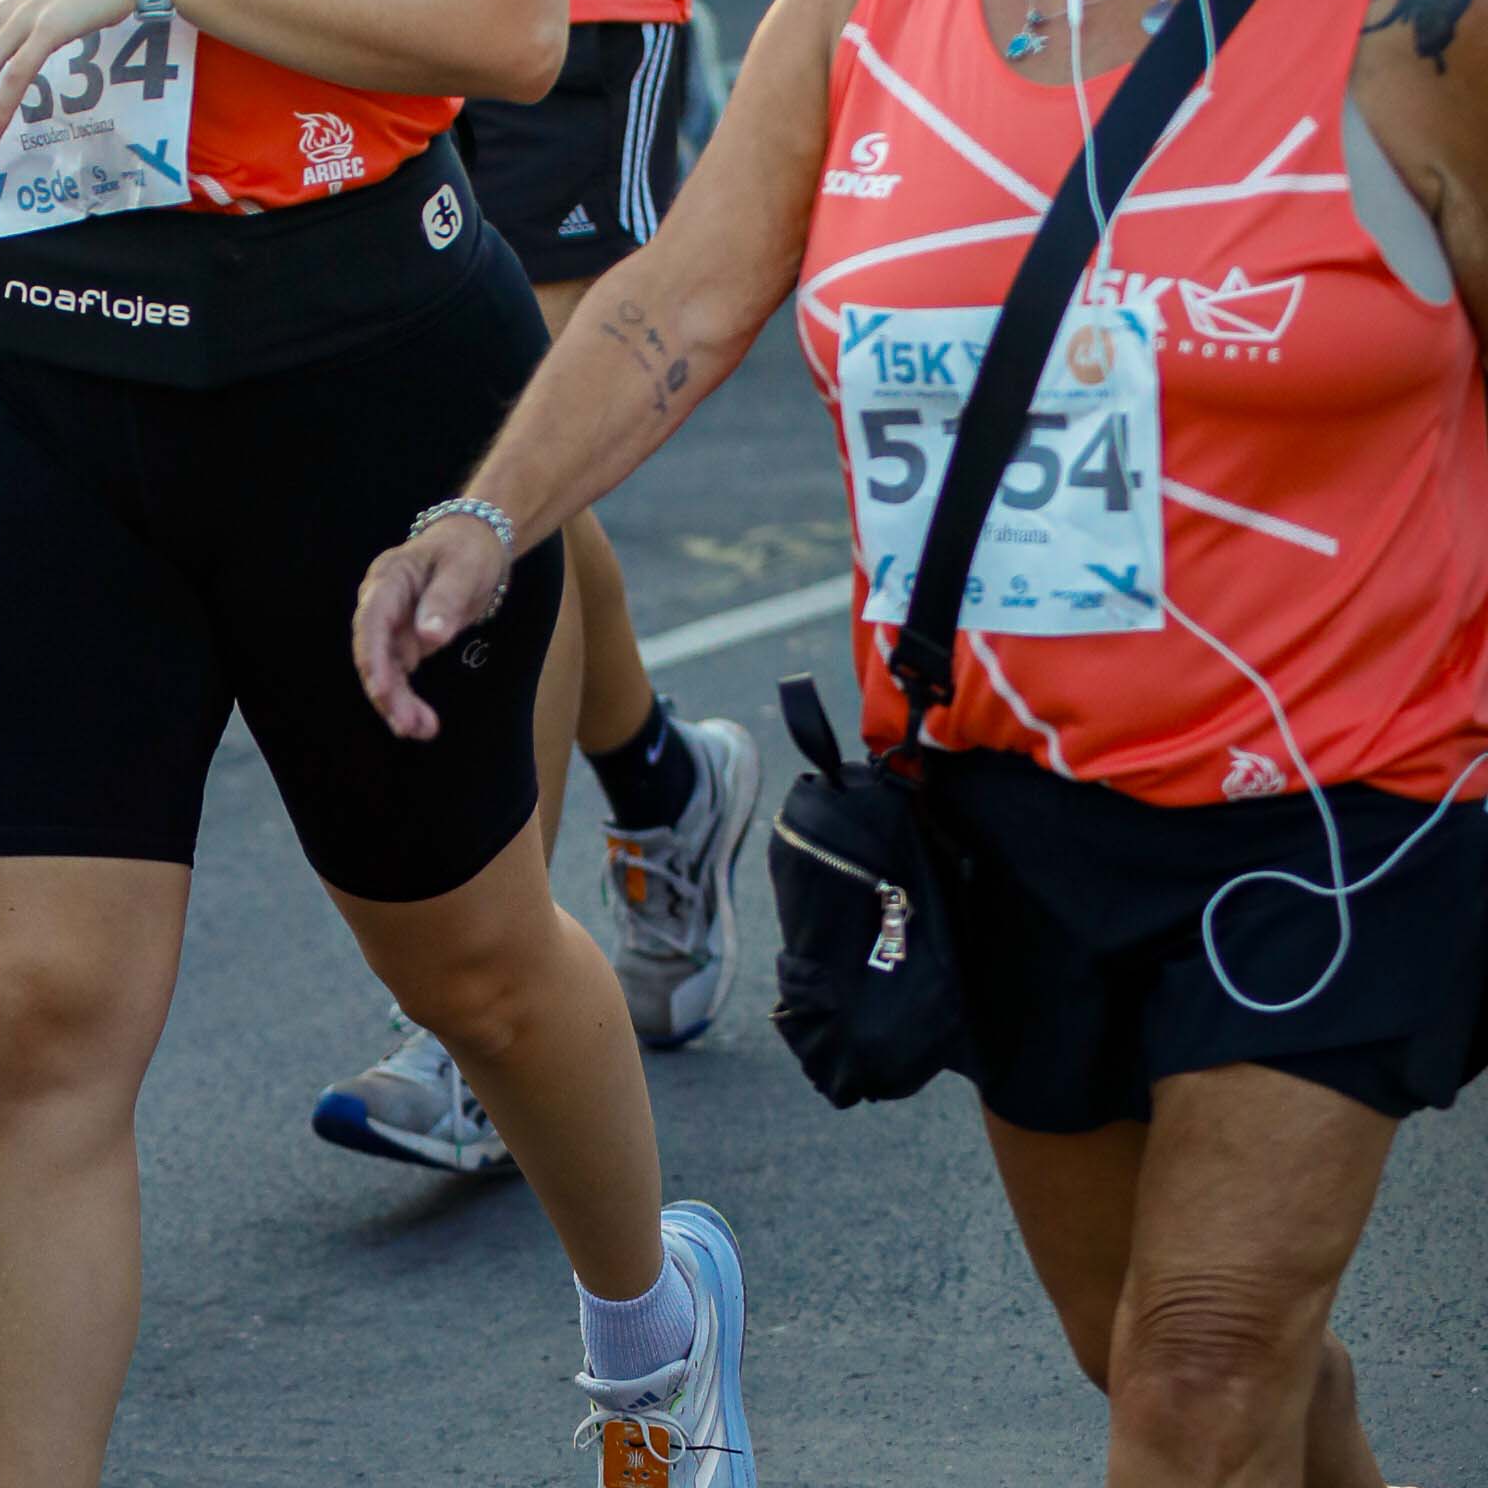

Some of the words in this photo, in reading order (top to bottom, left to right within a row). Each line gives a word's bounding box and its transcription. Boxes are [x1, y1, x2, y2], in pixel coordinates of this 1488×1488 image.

[17, 169, 80, 212] osde
[303, 157, 365, 186] ARDEC
[4, 279, 191, 328] noaflojes
[870, 340, 957, 385] 15K
[1177, 338, 1281, 364] NORTE
[859, 408, 1143, 513] 554
